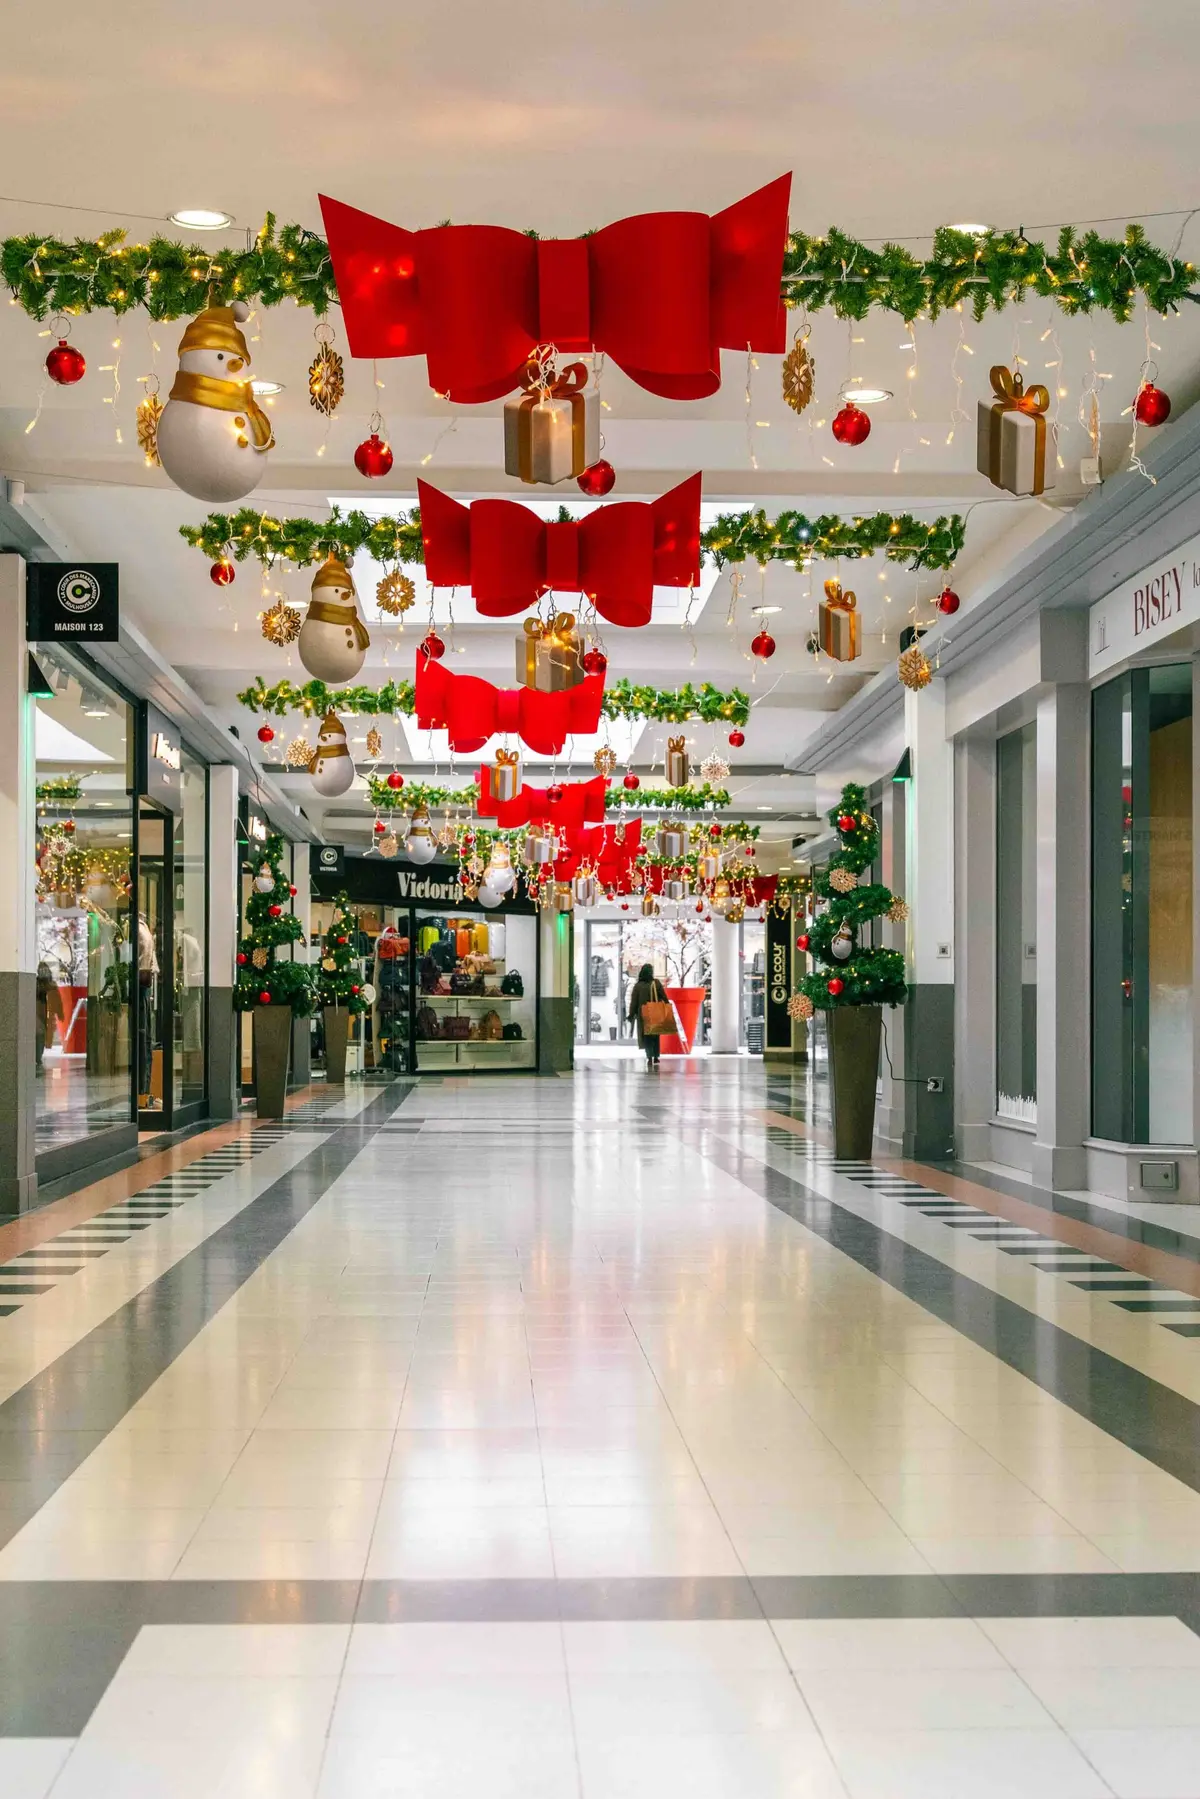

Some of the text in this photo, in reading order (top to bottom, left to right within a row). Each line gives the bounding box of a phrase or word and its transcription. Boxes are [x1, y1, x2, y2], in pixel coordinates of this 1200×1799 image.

[1133, 561, 1186, 636] BISEY
[54, 623, 104, 631] MAISON 123
[397, 872, 464, 901] Victoria
[773, 942, 782, 973] cour
[771, 973, 782, 985] la
